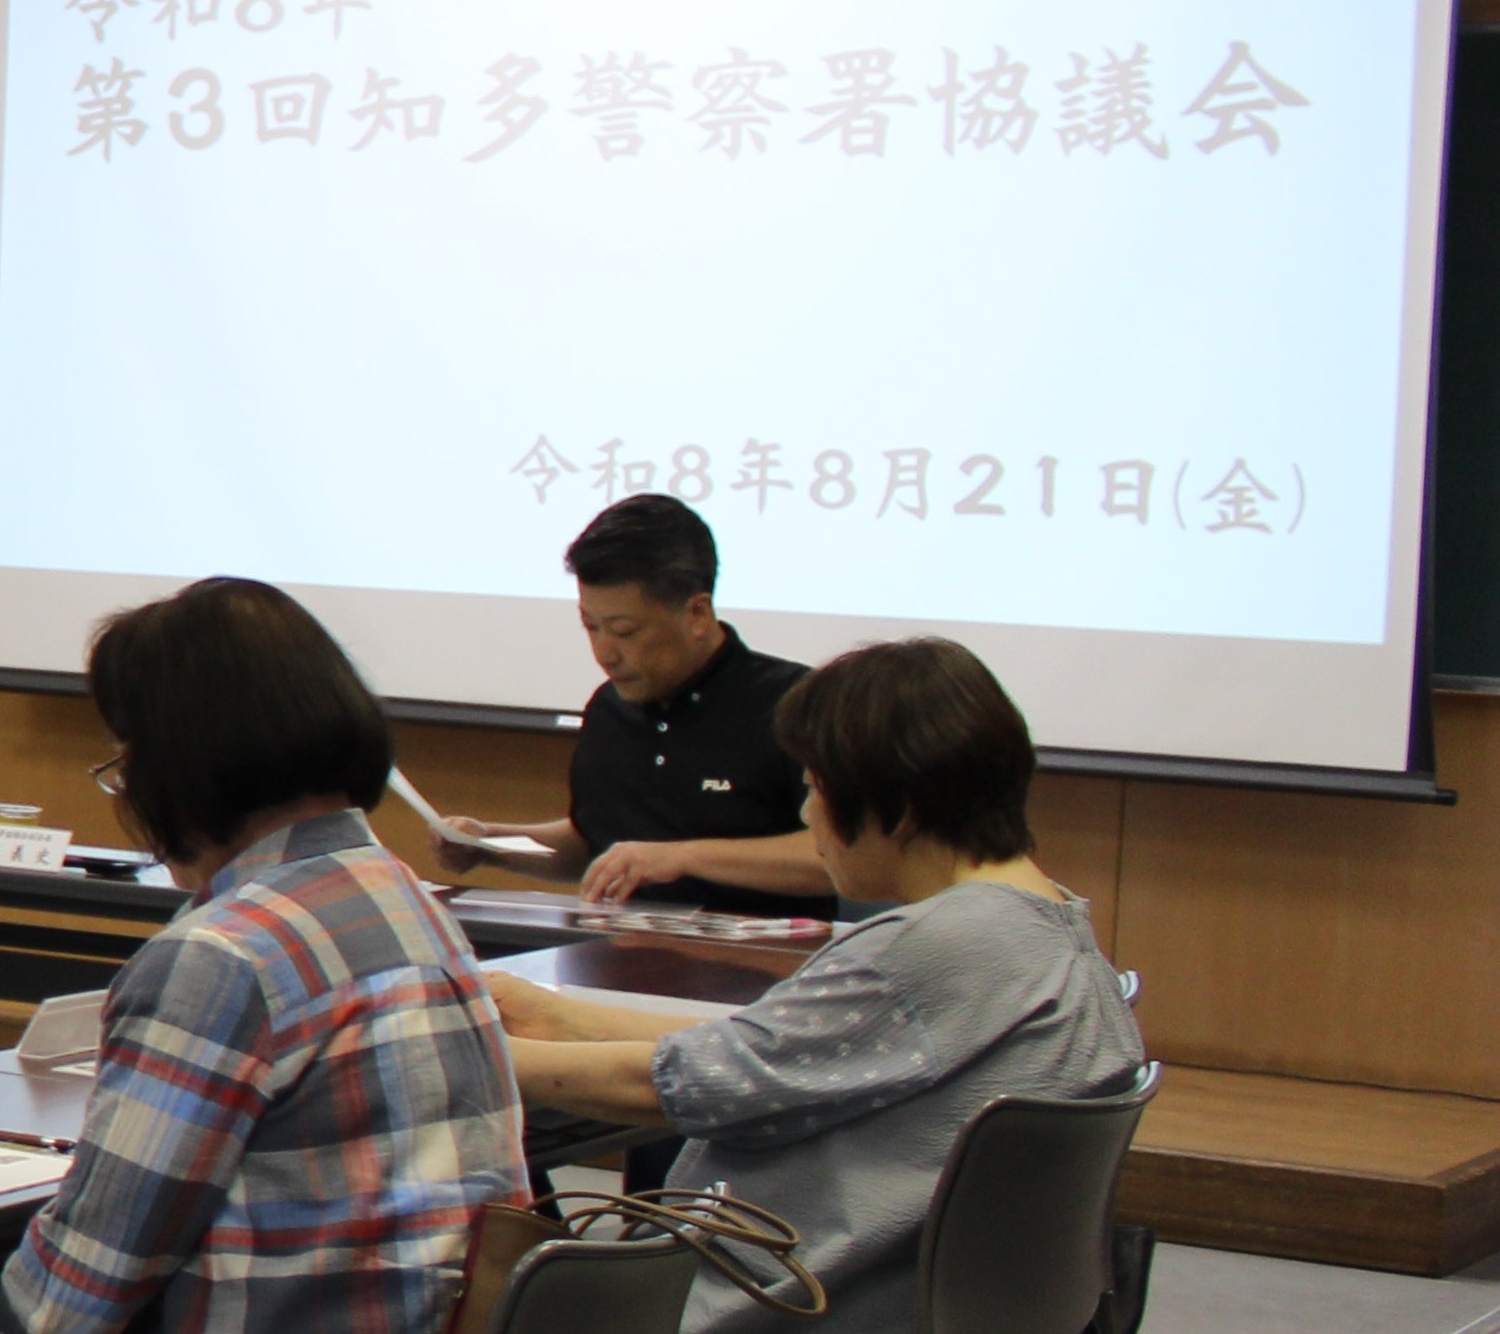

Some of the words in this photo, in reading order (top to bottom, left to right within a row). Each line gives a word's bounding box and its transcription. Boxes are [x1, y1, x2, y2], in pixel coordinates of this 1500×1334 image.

[64, 38, 1312, 163] 第3回知多警察署協議会
[701, 778, 731, 791] FILA
